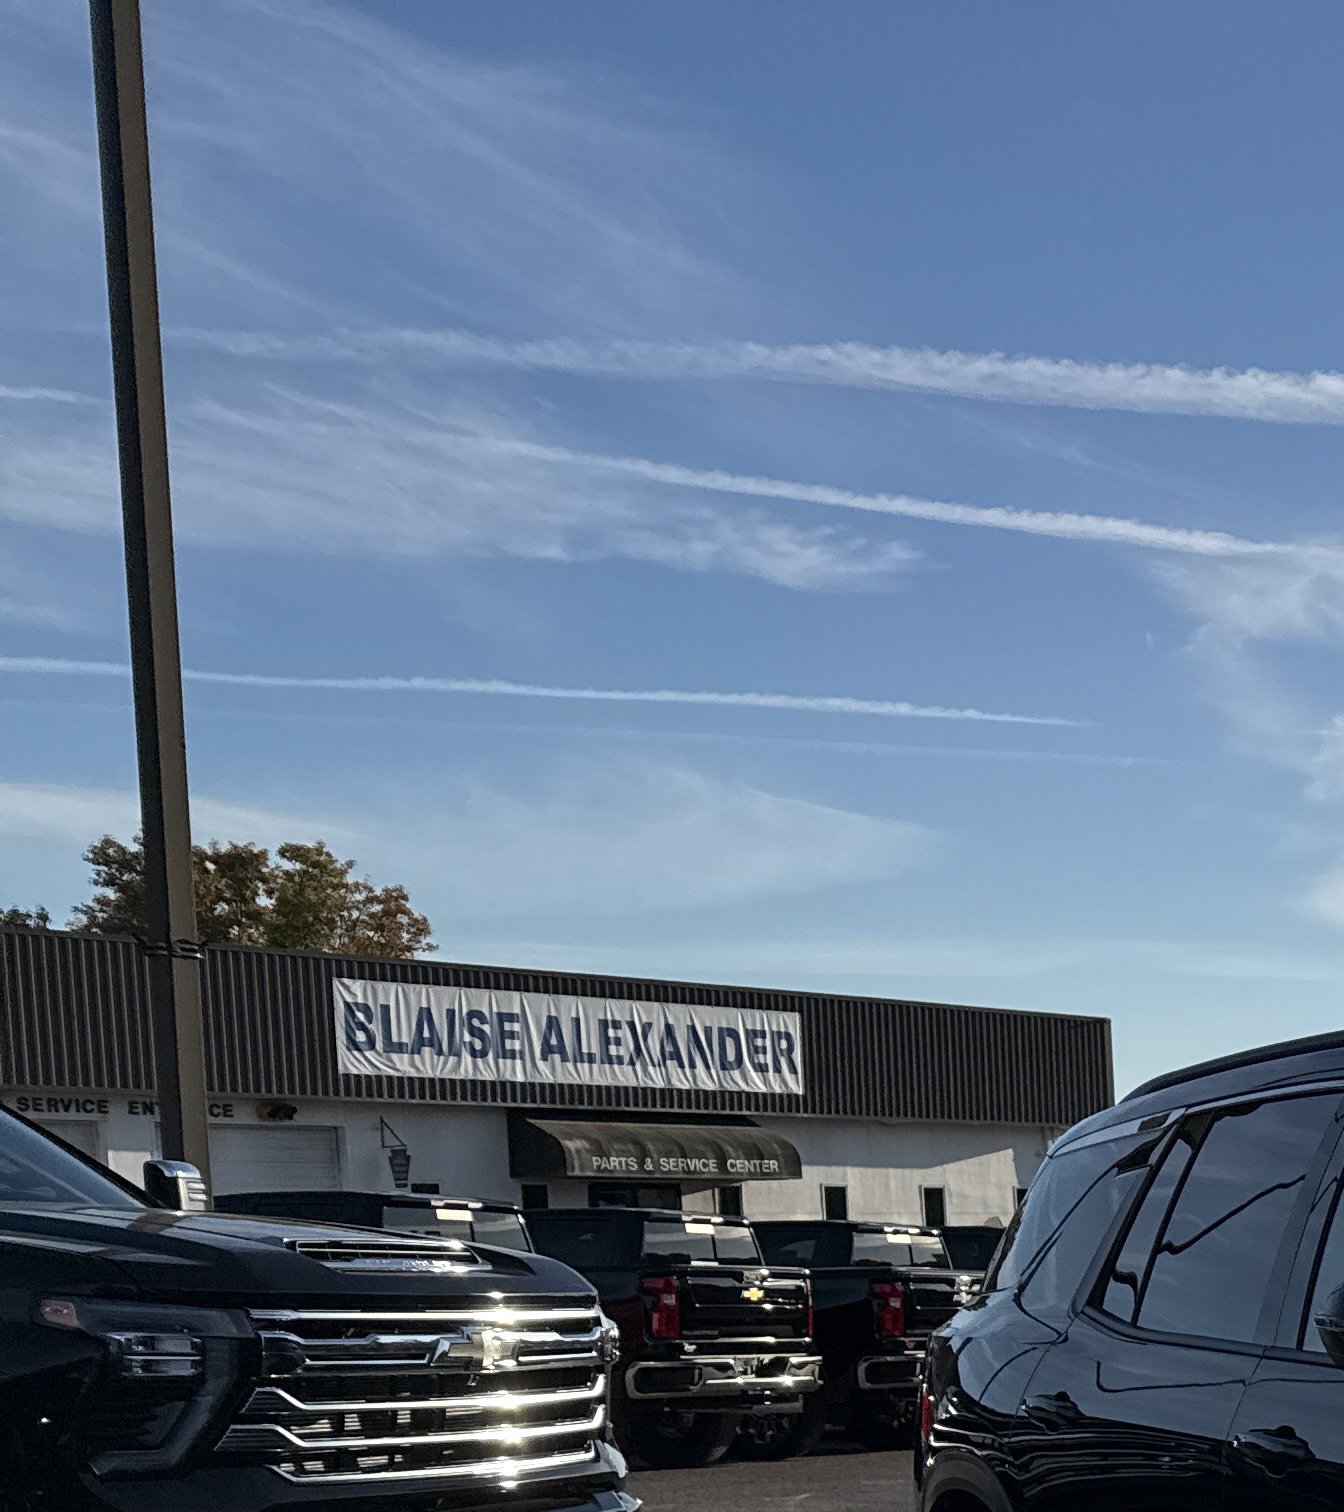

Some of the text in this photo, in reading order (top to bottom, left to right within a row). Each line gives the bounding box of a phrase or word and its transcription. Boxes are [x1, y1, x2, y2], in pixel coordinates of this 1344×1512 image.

[343, 1001, 799, 1075] BLAISE ALEXANDER
[16, 1096, 110, 1115] SERVICE
[591, 1156, 780, 1173] PARTS & SERVICE CENTER
